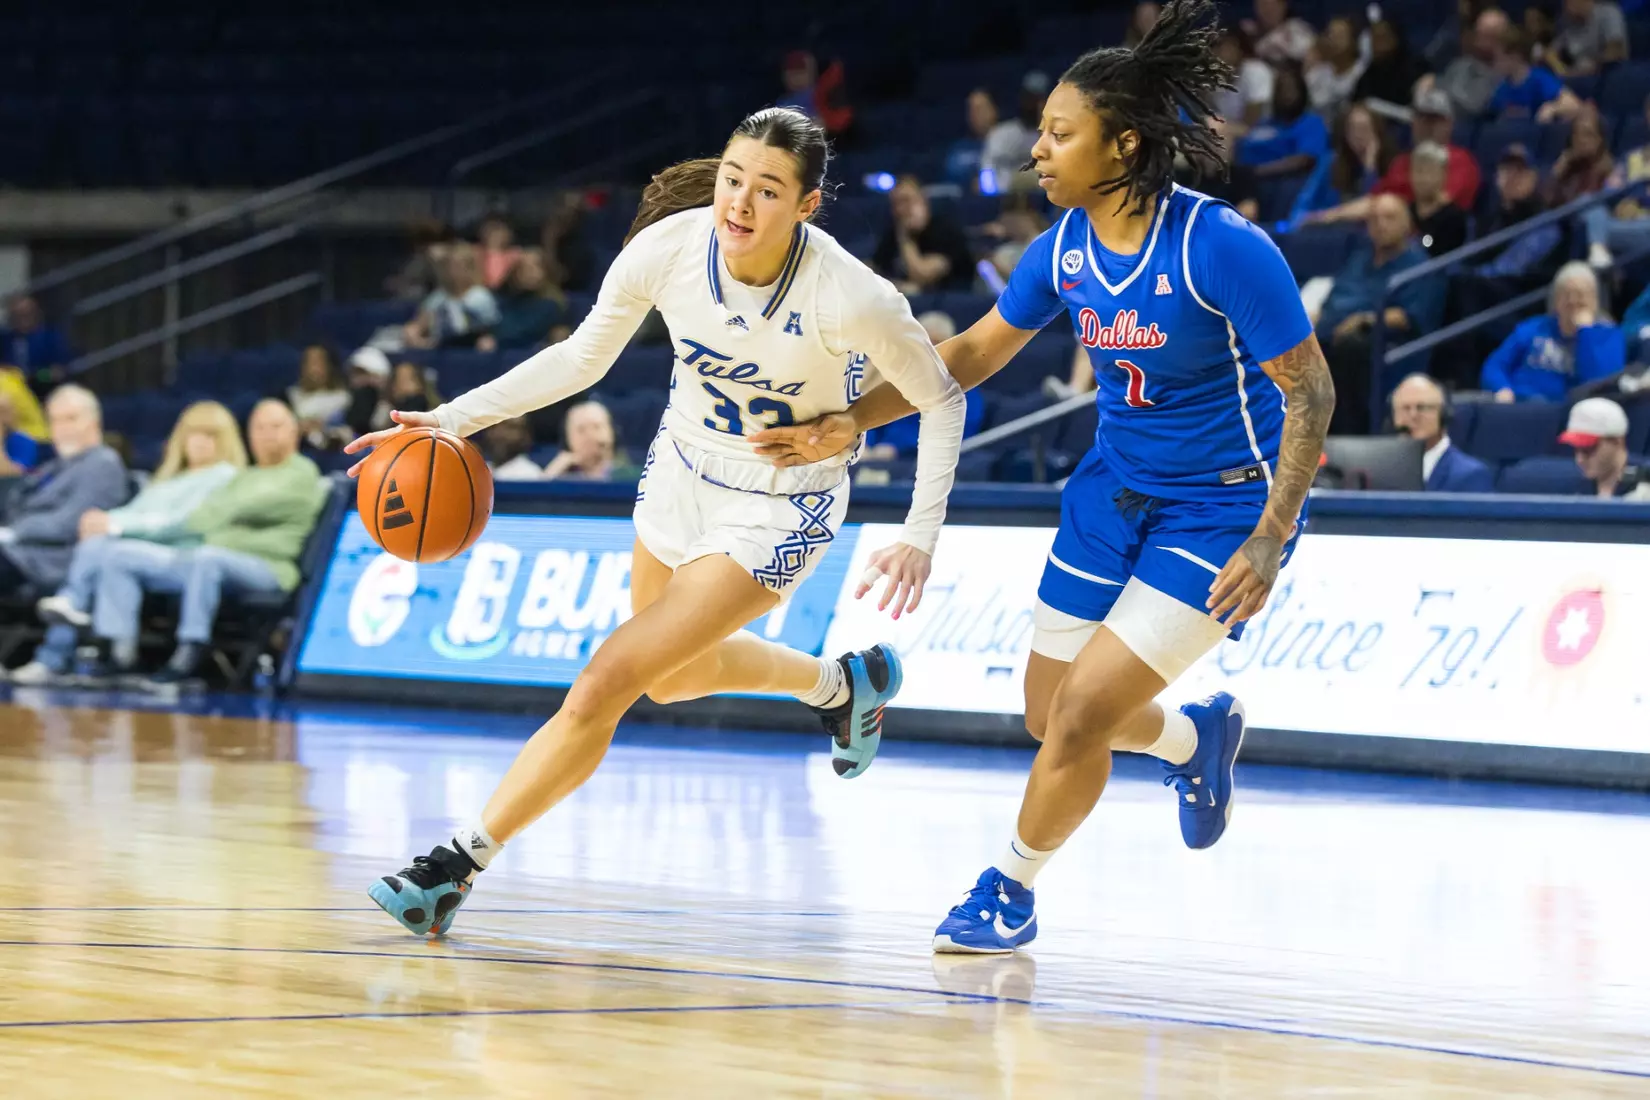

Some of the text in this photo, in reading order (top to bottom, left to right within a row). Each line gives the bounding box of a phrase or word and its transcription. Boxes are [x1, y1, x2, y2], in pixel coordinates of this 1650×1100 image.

[1079, 307, 1167, 350] Dallas
[679, 338, 808, 397] Tulsa
[1115, 359, 1155, 408] 1
[701, 380, 795, 437] 33
[517, 549, 634, 631] BUR
[1217, 578, 1384, 677] Since
